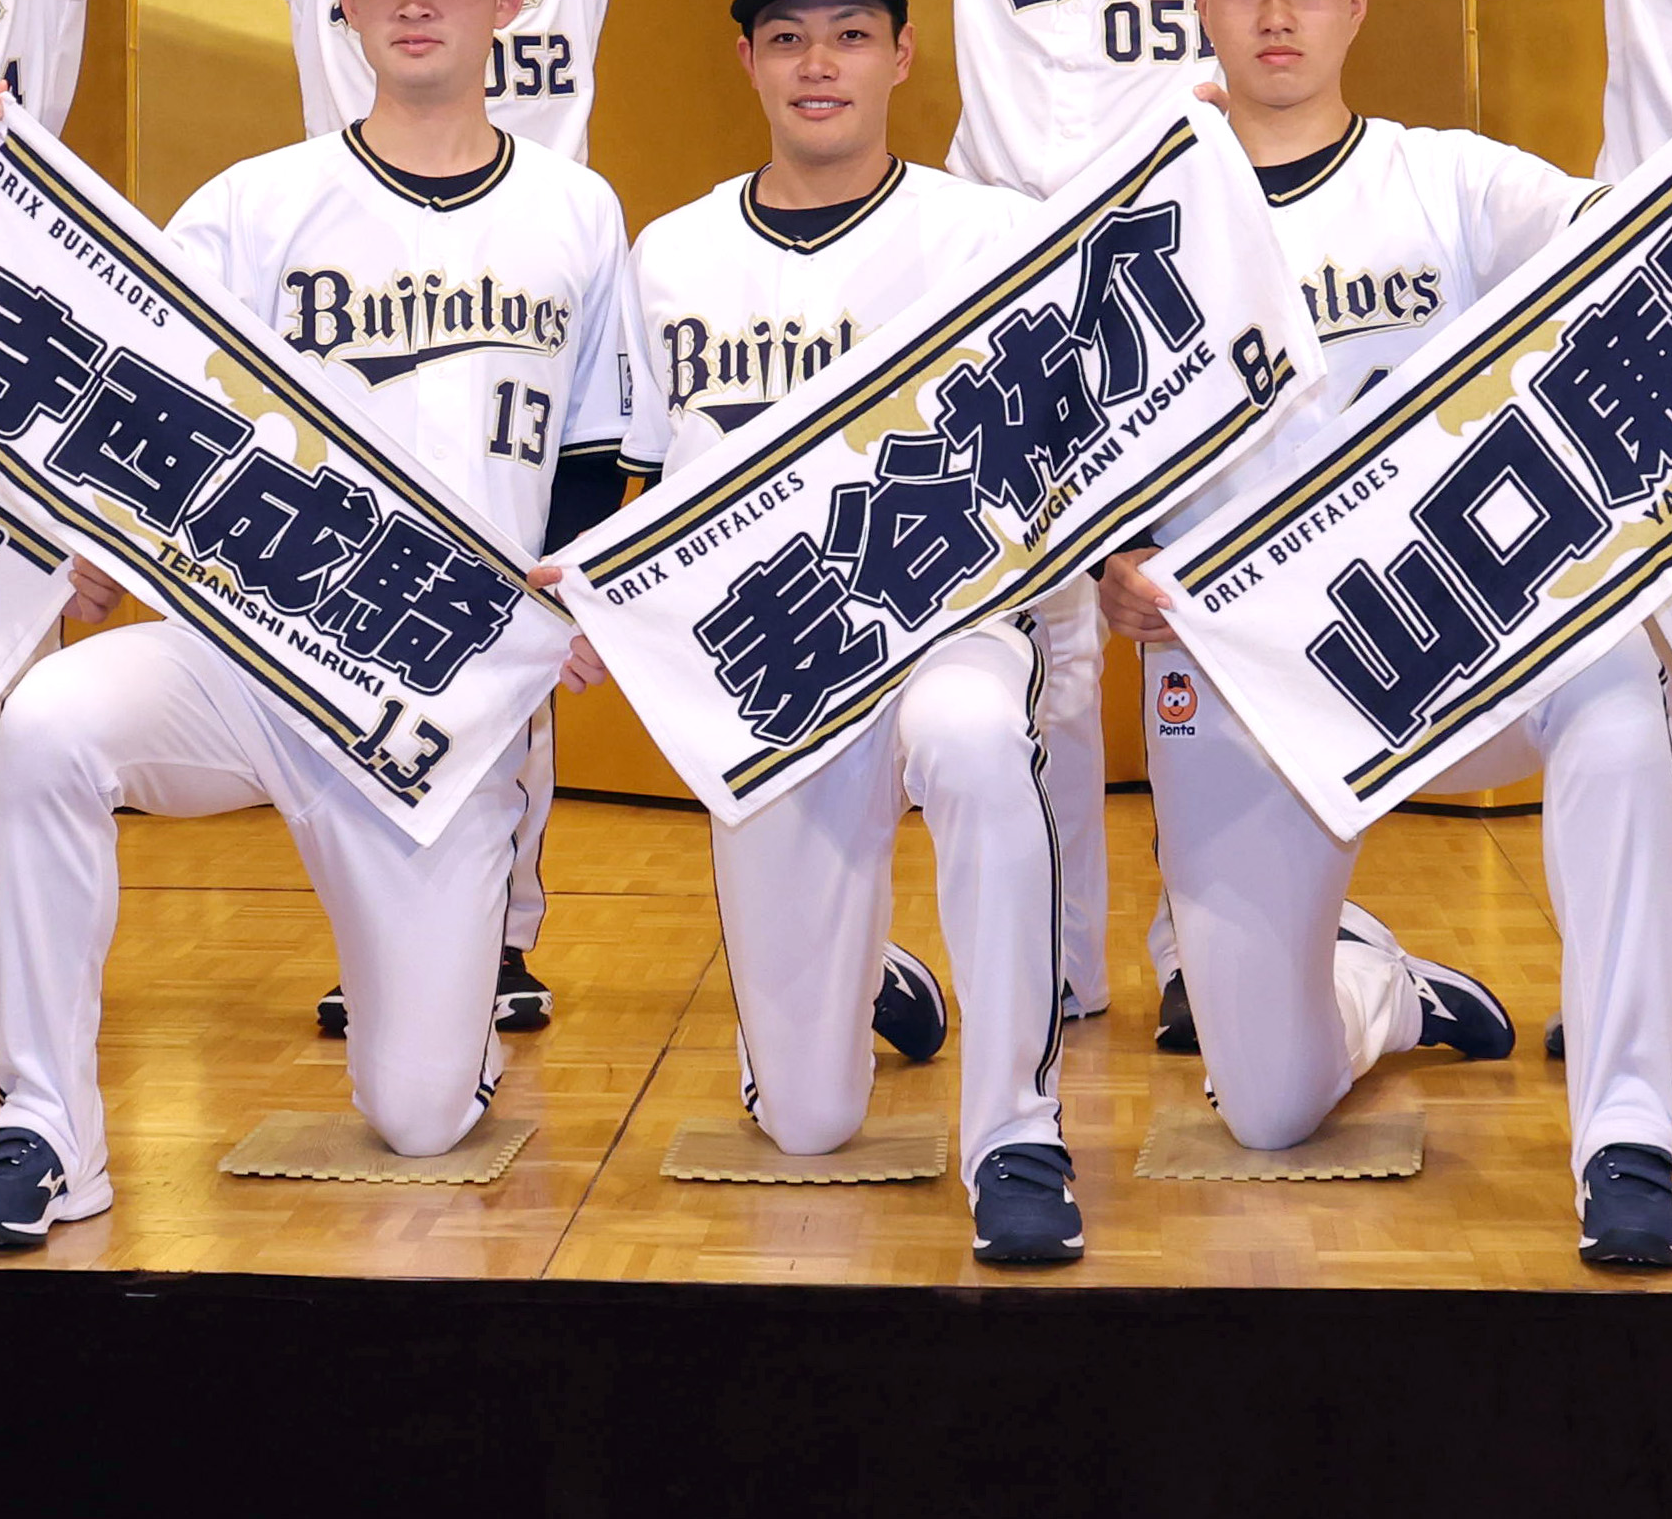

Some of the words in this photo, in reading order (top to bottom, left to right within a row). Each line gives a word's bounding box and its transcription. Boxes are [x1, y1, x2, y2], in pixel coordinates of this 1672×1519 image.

[48, 218, 171, 331] BUFFALOES
[283, 268, 573, 361] Buffaloes
[663, 308, 862, 419] Buffal
[1230, 323, 1278, 411] 8
[486, 378, 555, 470] 13
[693, 200, 1205, 751] 麦谷祐介
[1022, 439, 1125, 555] MUGITANI
[1119, 338, 1217, 441] YUSUKE
[606, 561, 669, 607] ORIX
[677, 469, 807, 568] BUFFALOES
[1203, 561, 1265, 615] ORIX
[1271, 455, 1402, 568] BUFFALOES
[156, 540, 286, 650] TERANISHI
[287, 628, 385, 699] NARUKI
[347, 695, 454, 791] 13
[1159, 724, 1196, 736] Ponta
